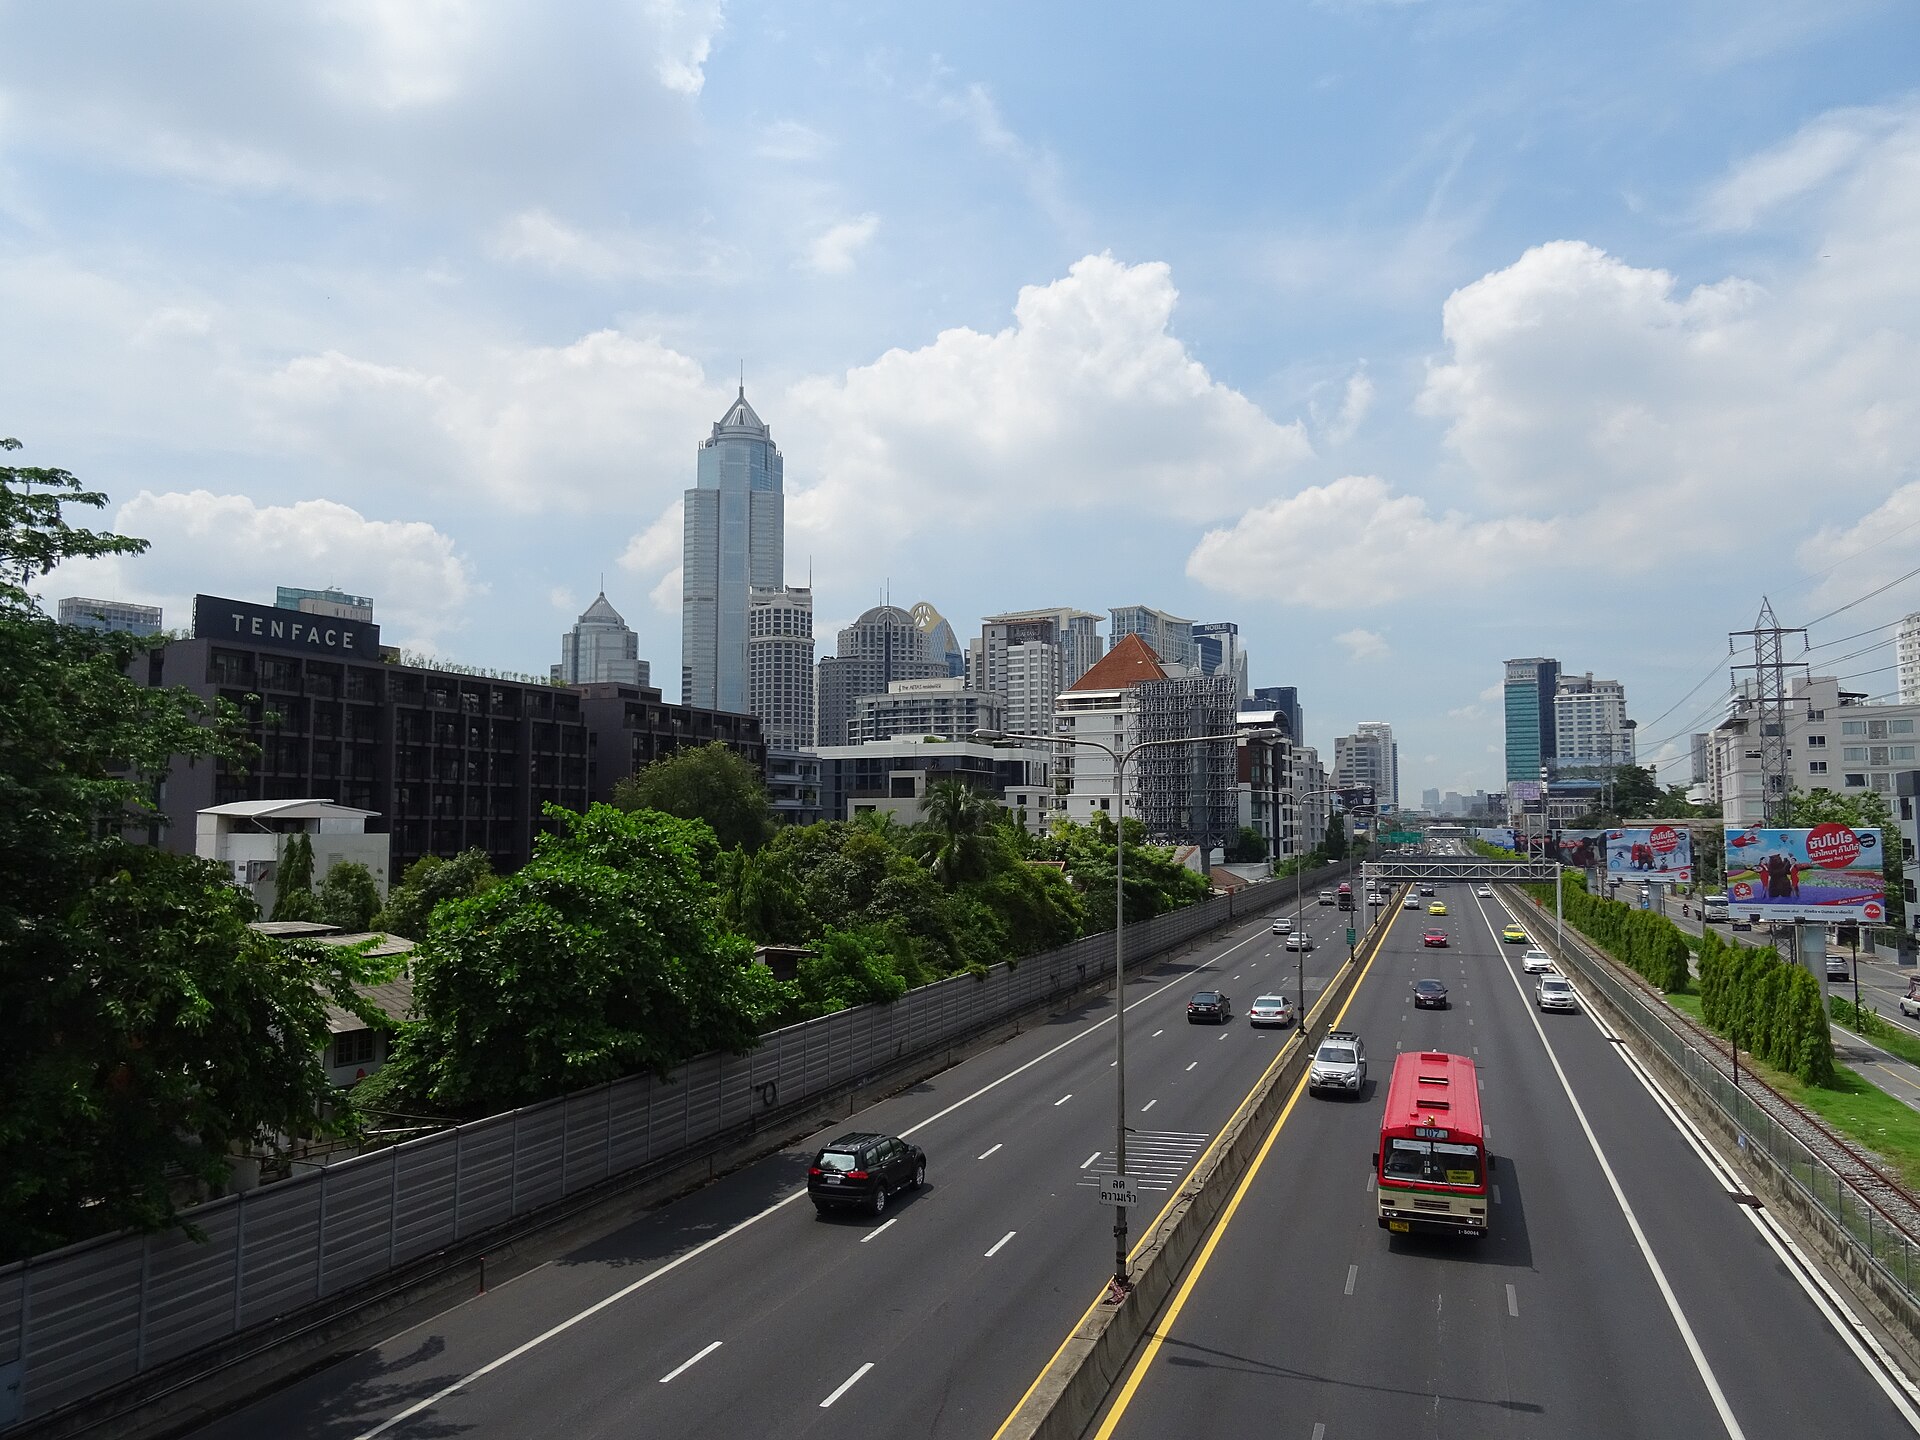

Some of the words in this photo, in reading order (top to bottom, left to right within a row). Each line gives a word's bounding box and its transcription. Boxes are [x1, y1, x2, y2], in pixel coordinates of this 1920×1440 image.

[232, 614, 353, 649] TENFACE
[1204, 623, 1227, 631] NOBLE
[1808, 831, 1853, 850] ซัปโปโร
[1425, 1128, 1440, 1138] 107
[1112, 1179, 1125, 1189] ลด
[1101, 1190, 1137, 1203] ความเร็ว
